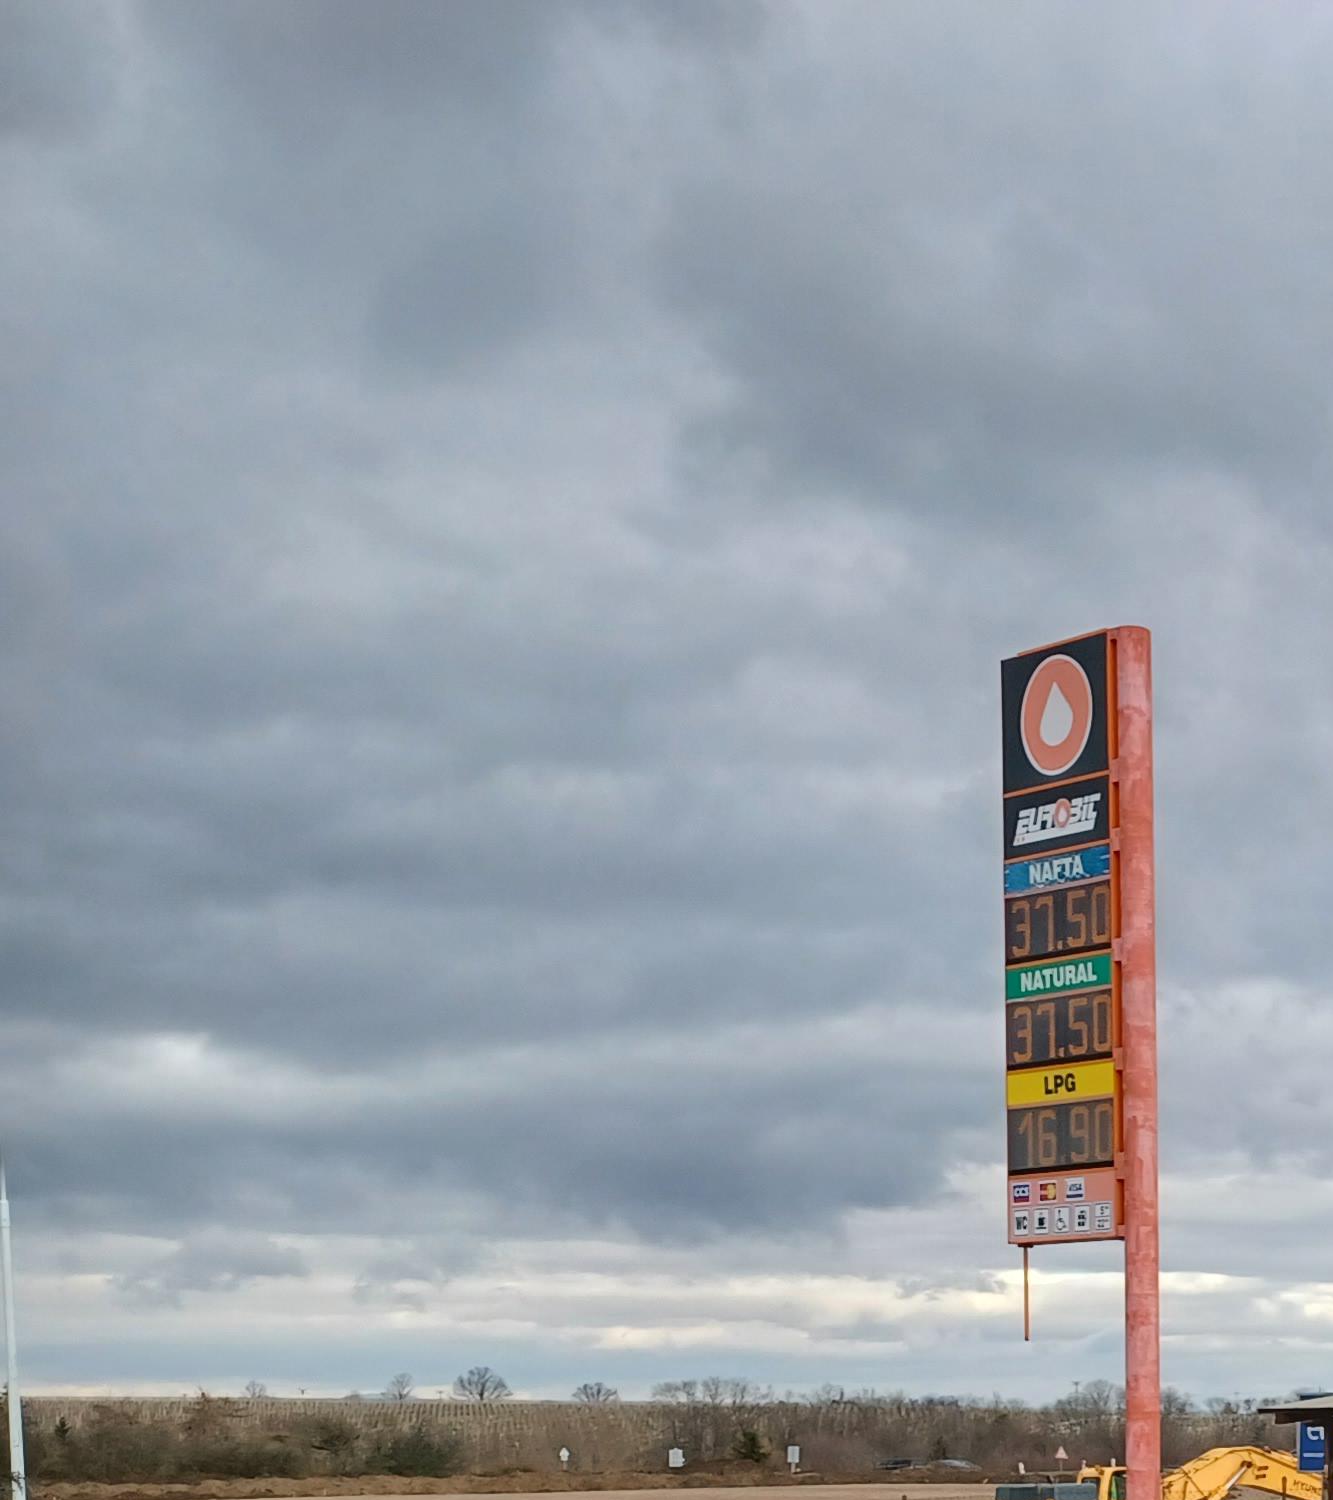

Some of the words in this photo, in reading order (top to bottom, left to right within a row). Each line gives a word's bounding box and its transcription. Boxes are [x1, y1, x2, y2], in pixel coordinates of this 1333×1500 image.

[1028, 855, 1088, 886] NAFTA
[1012, 885, 1110, 957] 37.50
[1020, 962, 1097, 992] NATURAL
[1013, 994, 1111, 1063] 37.50
[1044, 1073, 1076, 1095] LPG
